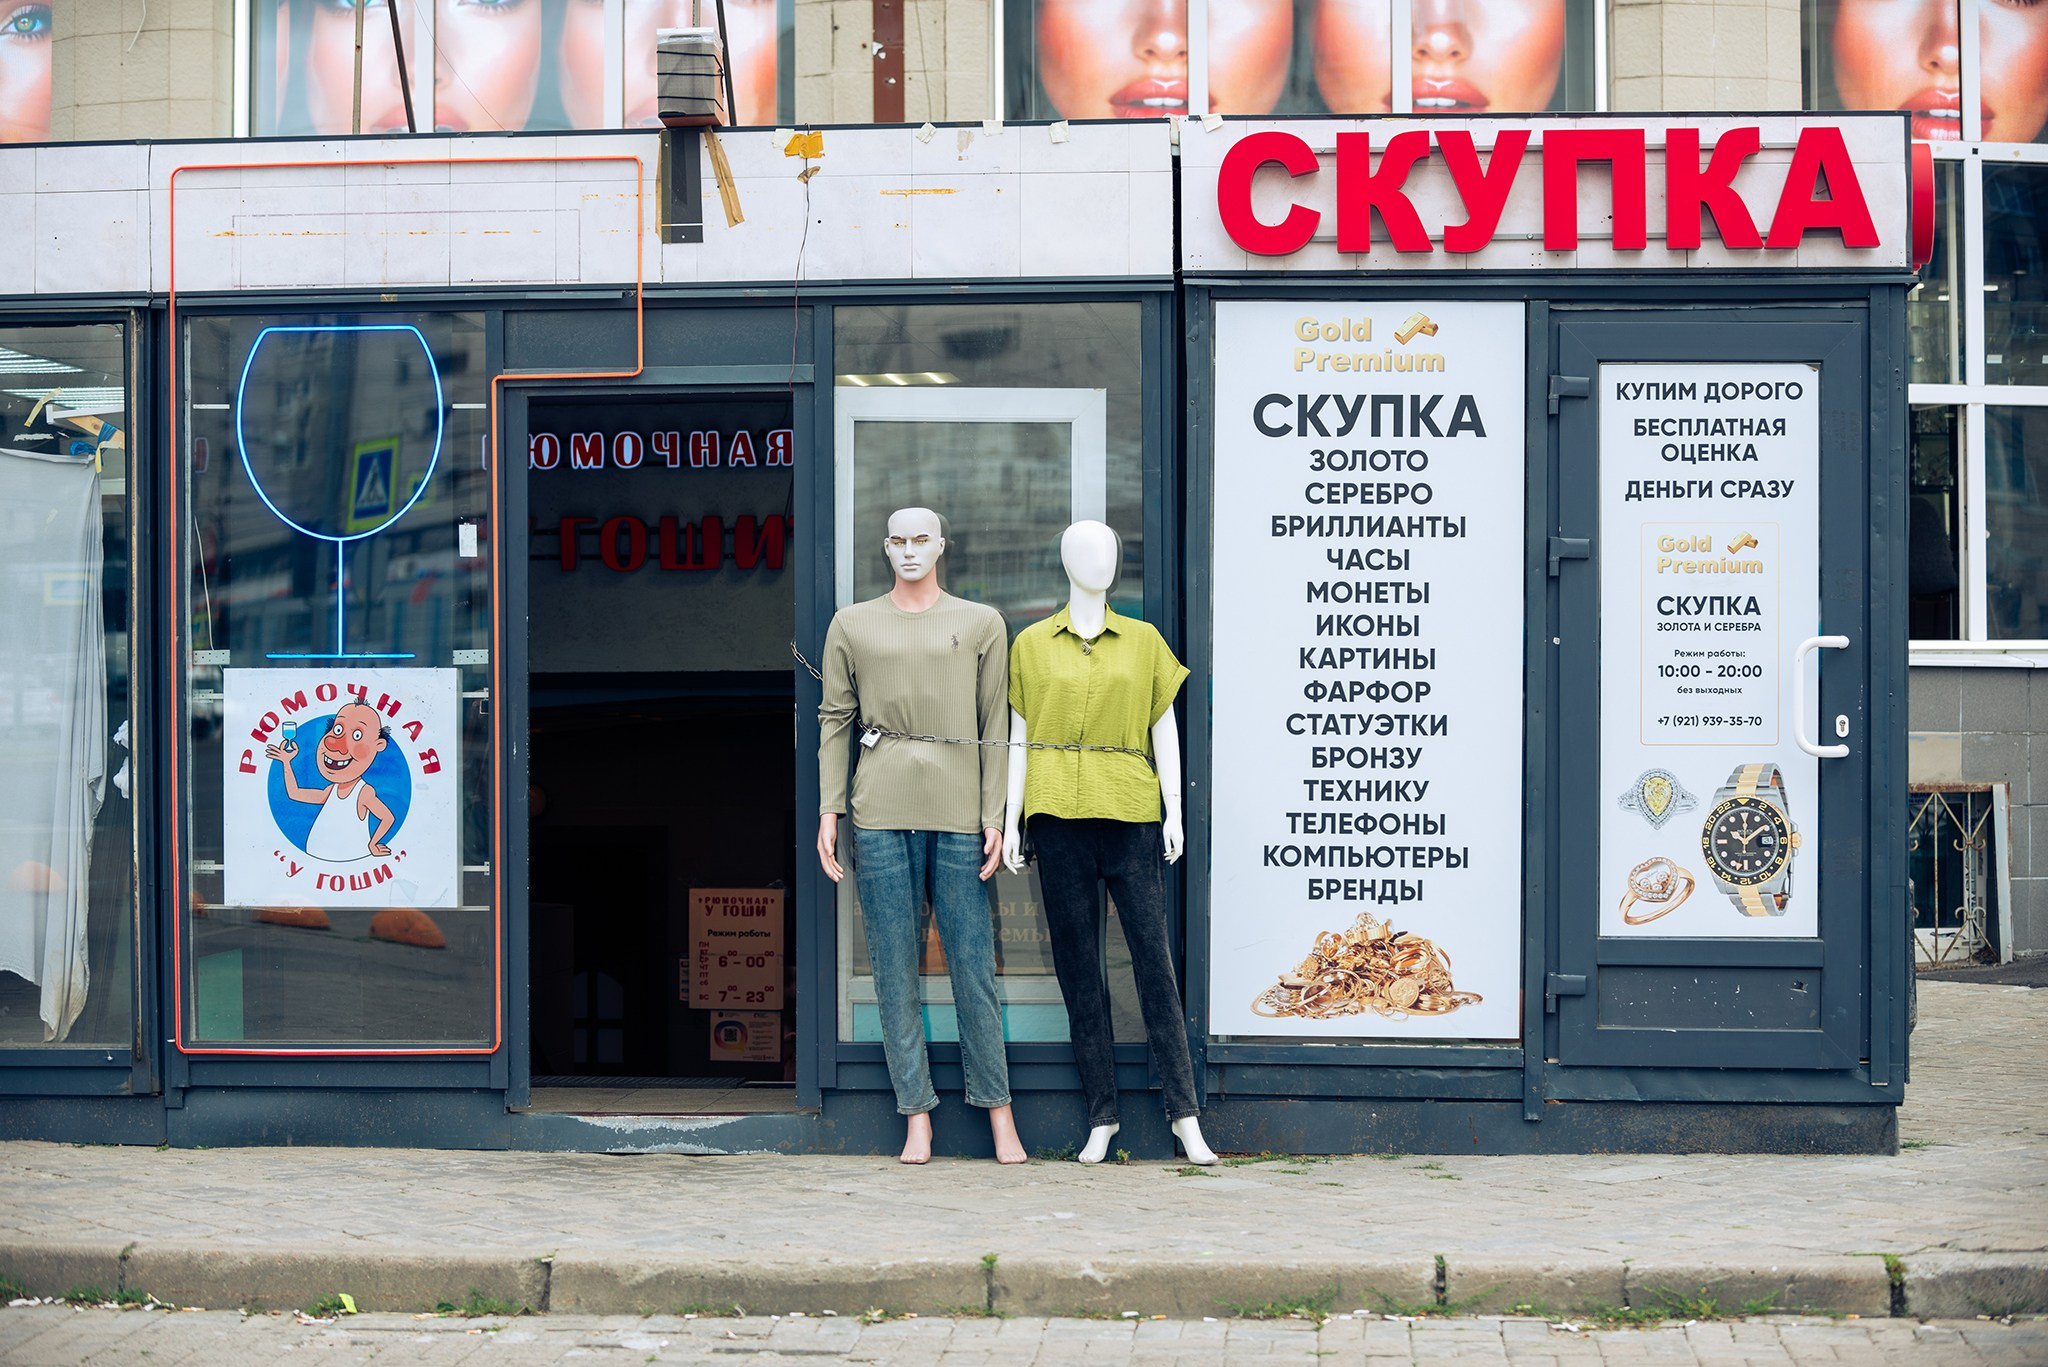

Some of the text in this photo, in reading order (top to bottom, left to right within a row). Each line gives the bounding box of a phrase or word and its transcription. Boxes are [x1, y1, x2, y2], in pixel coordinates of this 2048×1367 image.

[1217, 126, 1881, 255] СКУПКА
[1294, 316, 1372, 344] Gold
[1293, 344, 1445, 372] Premium
[1616, 381, 1804, 403] КУПИМ ДОРОГО
[1253, 393, 1487, 438] СКУПКА
[1633, 417, 1787, 438] БЕСПЛАТНАЯ
[482, 429, 794, 471] ЮМОЧНАЯ
[1309, 450, 1429, 472] ЗОЛОТО
[1660, 443, 1759, 465] ОЦЕНКА
[1304, 482, 1433, 505] СЕРЕБРО
[1624, 479, 1795, 503] ДЕНЬГИ СРАЗУ
[1271, 515, 1466, 538] БРИЛЛИАНТЫ
[1656, 534, 1712, 555] Gold
[1326, 548, 1410, 571] ЧАСЫ
[1656, 554, 1764, 575] Premium
[1306, 581, 1430, 604] МОНЕТЫ
[1656, 595, 1762, 616] СКУПКА
[1316, 614, 1420, 637] ИКОНЫ
[1657, 622, 1762, 632] ЗОЛОТА И СЕРЕБРА
[1299, 647, 1436, 670] КАРТИНЫ
[1674, 649, 1746, 660] Режим работы:
[1657, 664, 1701, 678] 10:00
[1717, 664, 1763, 678] 20:00
[1303, 680, 1431, 703] ФАРФОР
[1676, 685, 1743, 696] без выходных
[239, 683, 441, 775] РЮМОЧНАЯ
[1286, 713, 1448, 737] СТАТУЭТКИ
[1657, 714, 1763, 728] +7 (921) 939-35-70
[1312, 746, 1423, 770] БРОНЗУ
[1303, 779, 1430, 802] ТЕХНИКУ
[1285, 812, 1446, 836] ТЕЛЕФОНЫ
[1263, 845, 1469, 869] КОМПЬЮТЕРЫ
[705, 897, 768, 905] РЮМОЧНАЯ
[1308, 878, 1423, 905] БРЕНДЫ
[705, 905, 767, 917] У ГОШИ
[708, 929, 736, 937] Режим
